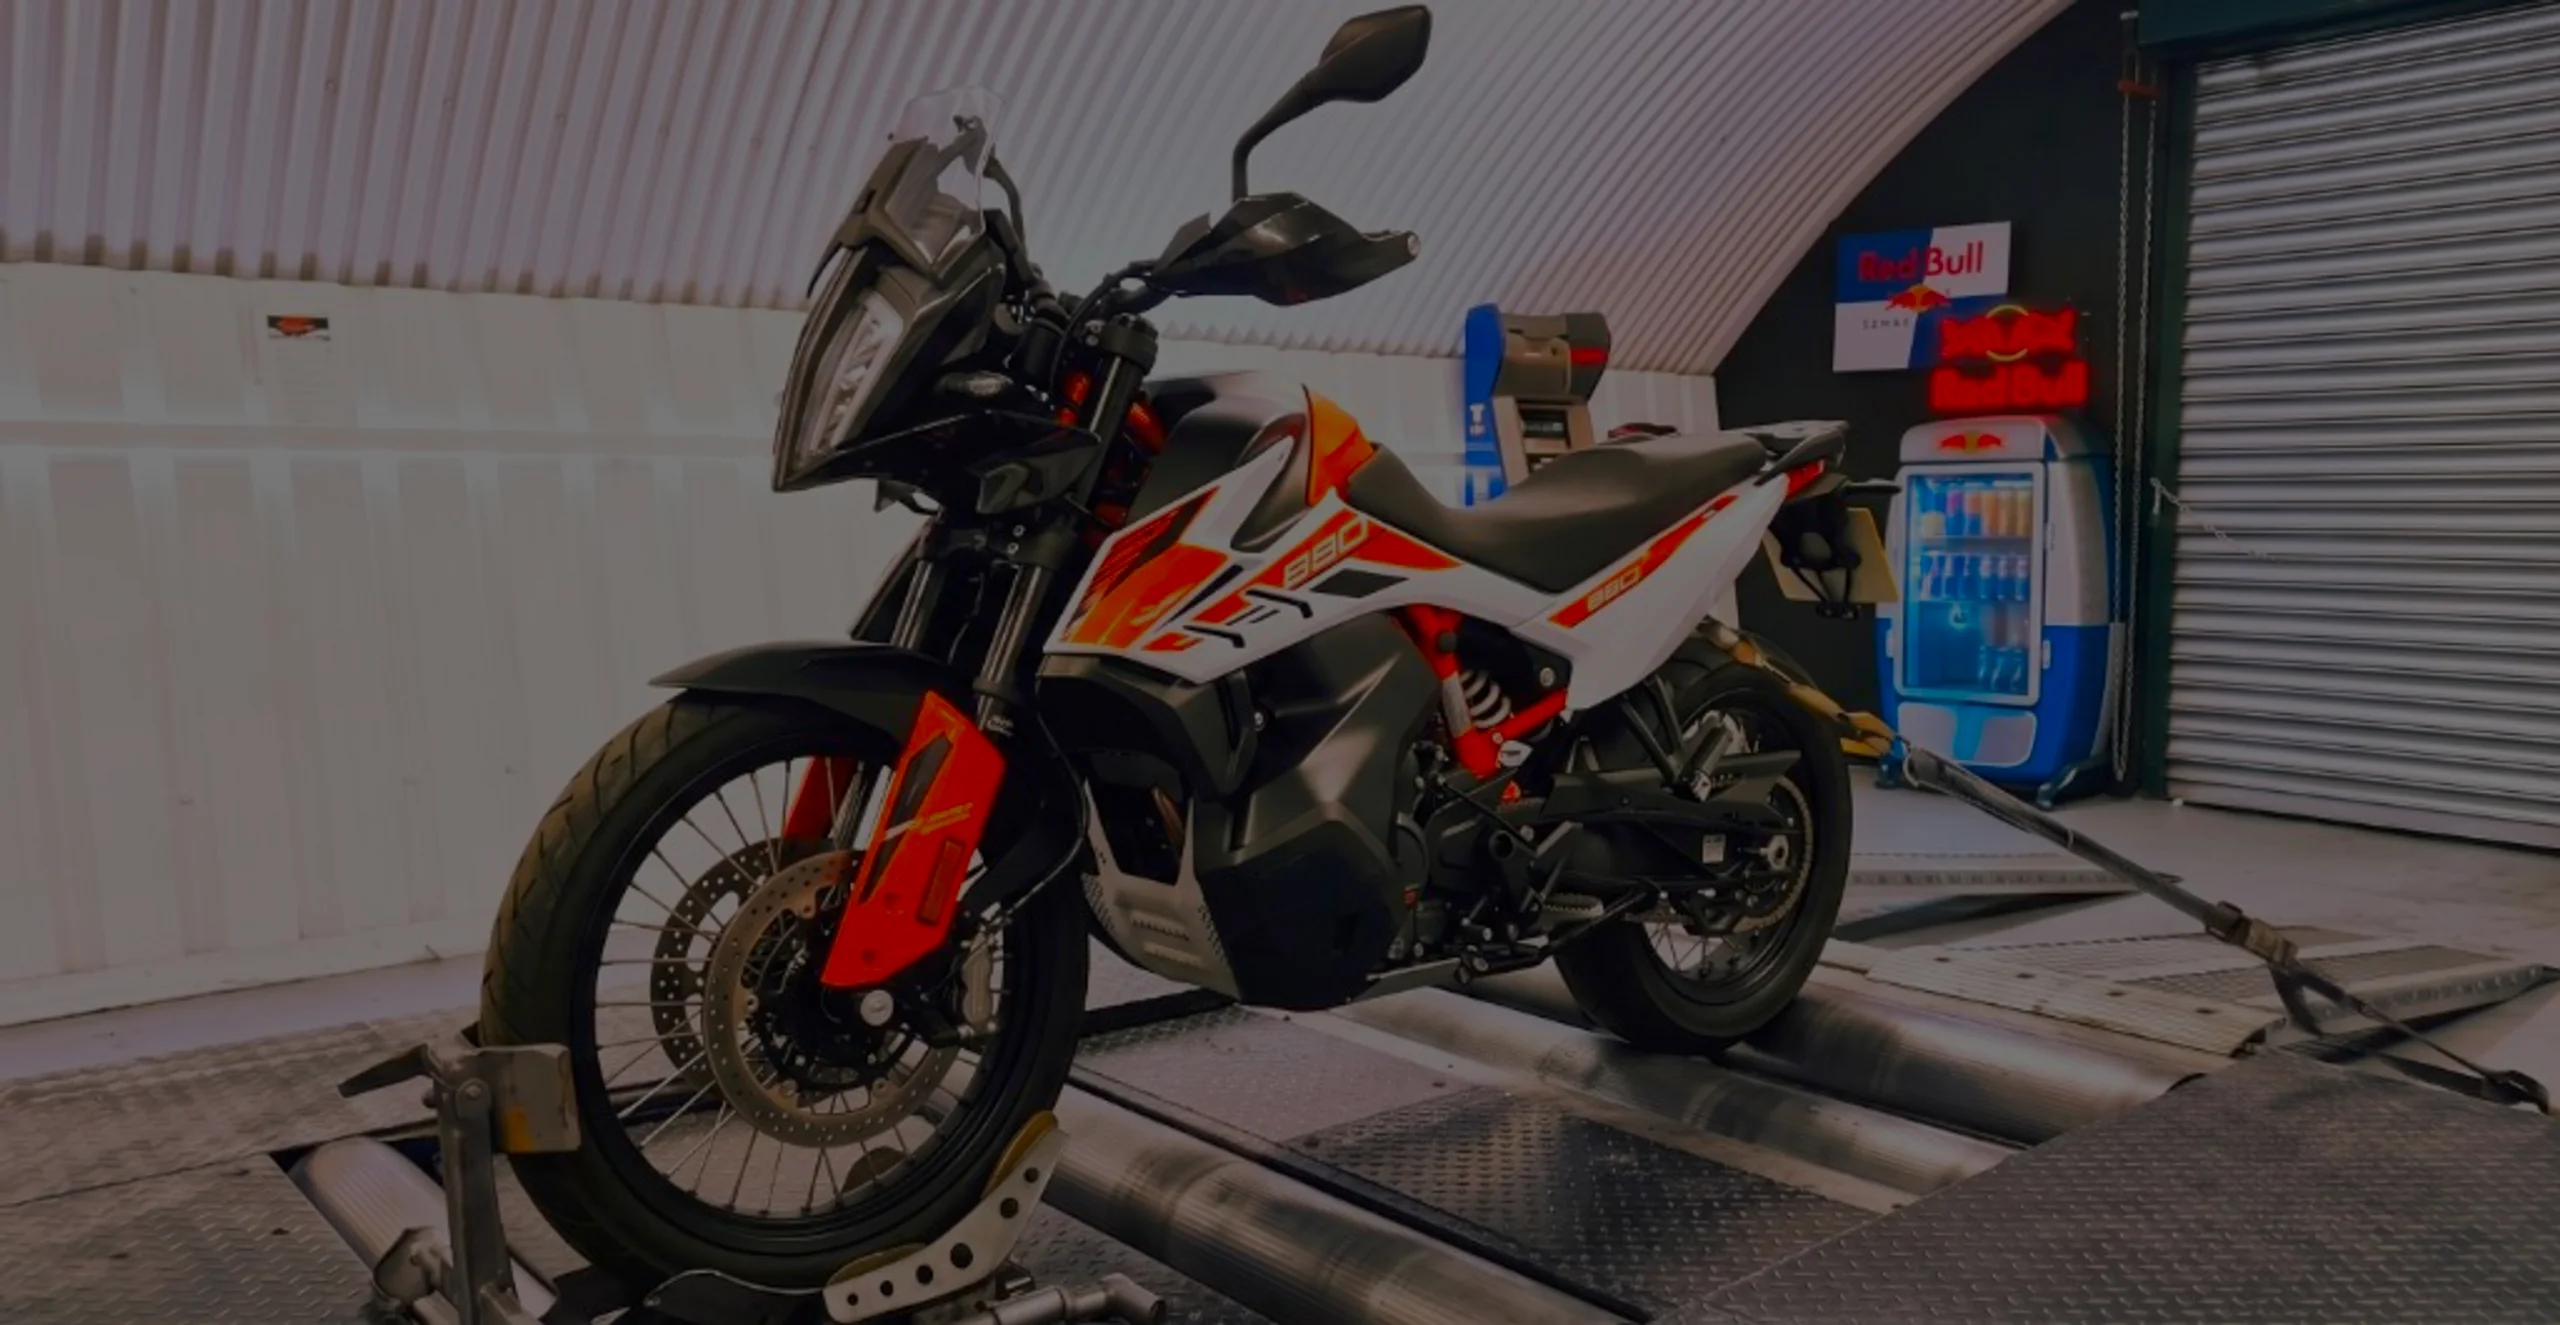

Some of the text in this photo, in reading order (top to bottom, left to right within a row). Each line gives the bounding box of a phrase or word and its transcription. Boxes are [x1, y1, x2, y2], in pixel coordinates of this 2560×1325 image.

[1858, 241, 1984, 282] Red Bull
[1932, 360, 2088, 409] Red Bull
